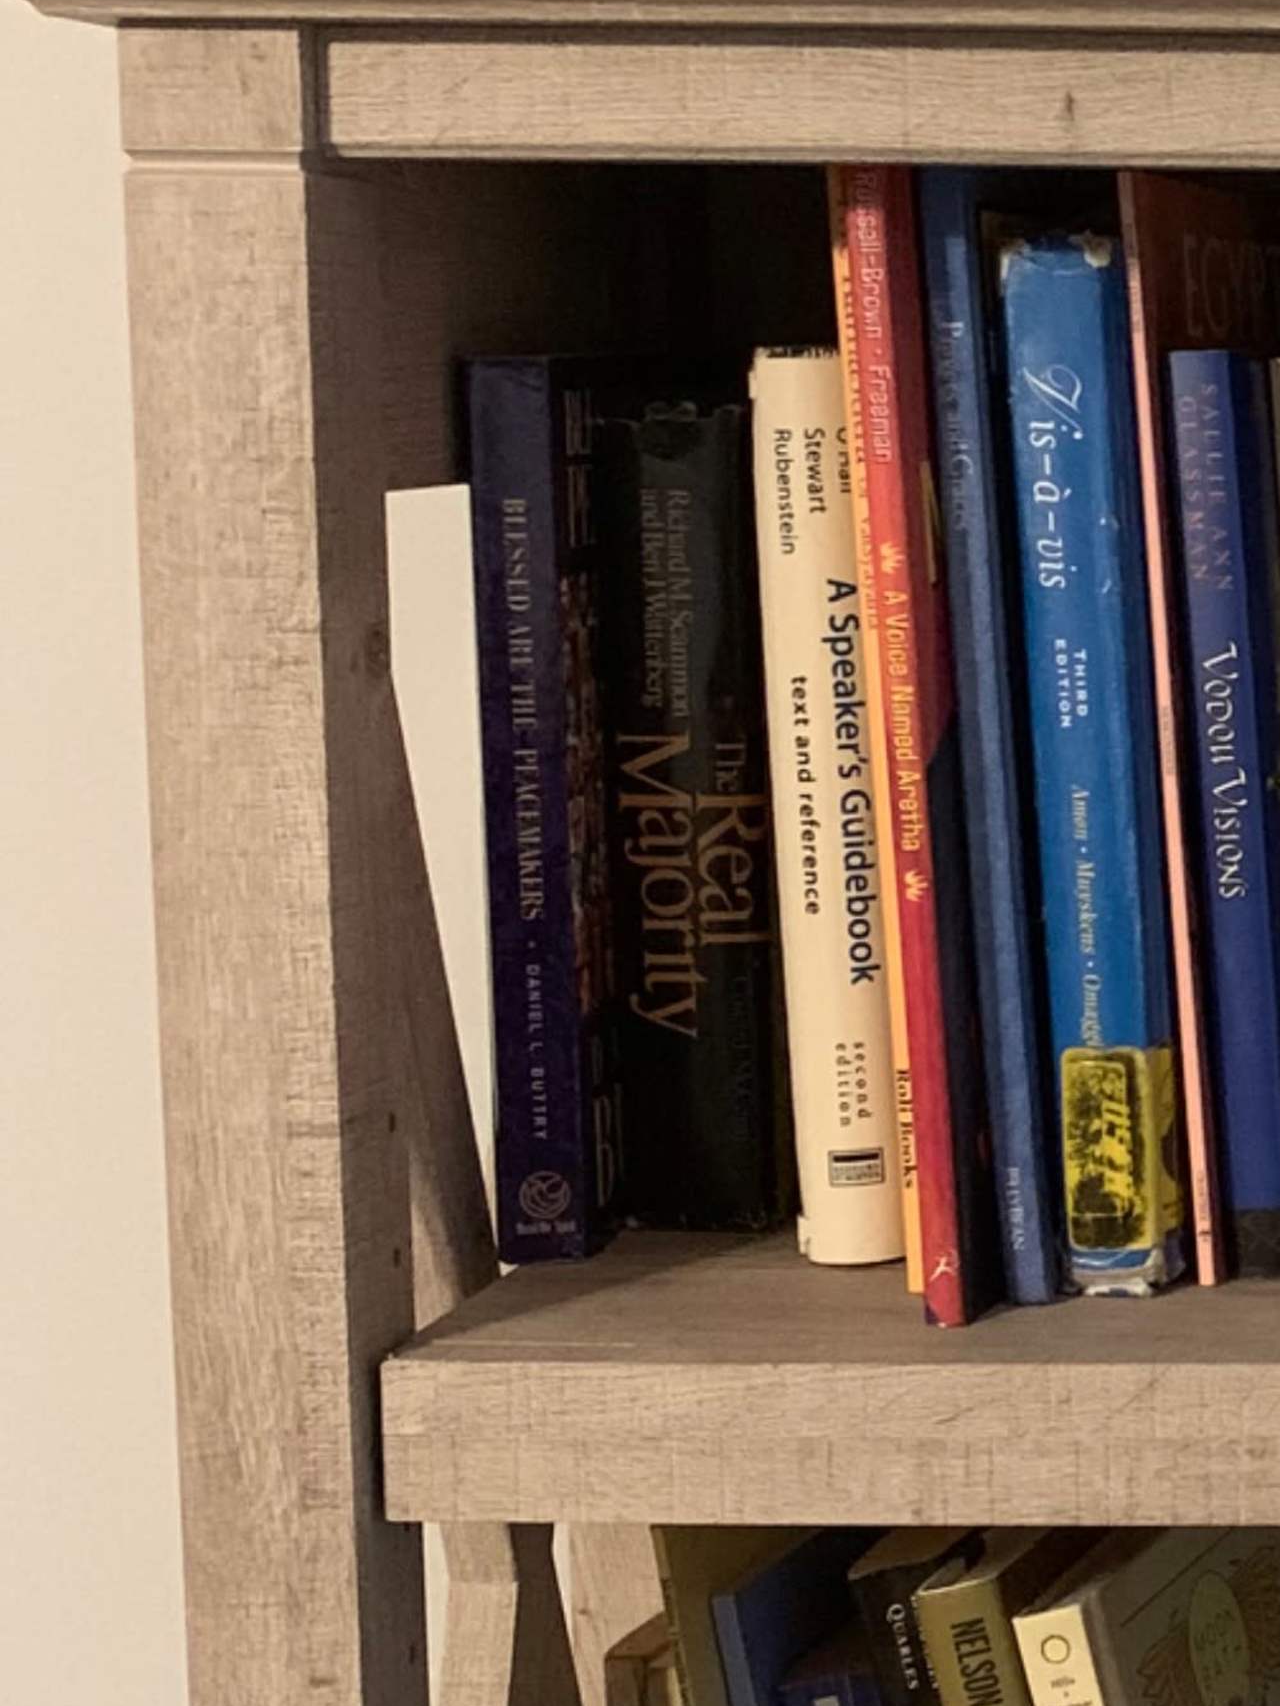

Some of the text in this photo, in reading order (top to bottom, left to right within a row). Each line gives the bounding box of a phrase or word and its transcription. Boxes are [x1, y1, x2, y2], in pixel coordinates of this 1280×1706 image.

[773, 427, 798, 554] Rubenstein
[803, 427, 827, 514] Stewart
[827, 578, 859, 604] A
[820, 613, 869, 780] Speaker's
[886, 612, 925, 852] Voice Named Aretha
[1053, 638, 1073, 729] EDITION
[1072, 649, 1089, 717] THIRD
[789, 675, 823, 915] text and reference
[616, 732, 699, 1042] Majority
[697, 791, 776, 945] Real
[838, 787, 880, 986] Guidebook
[834, 1042, 854, 1128] edition
[852, 1040, 874, 1119] second
